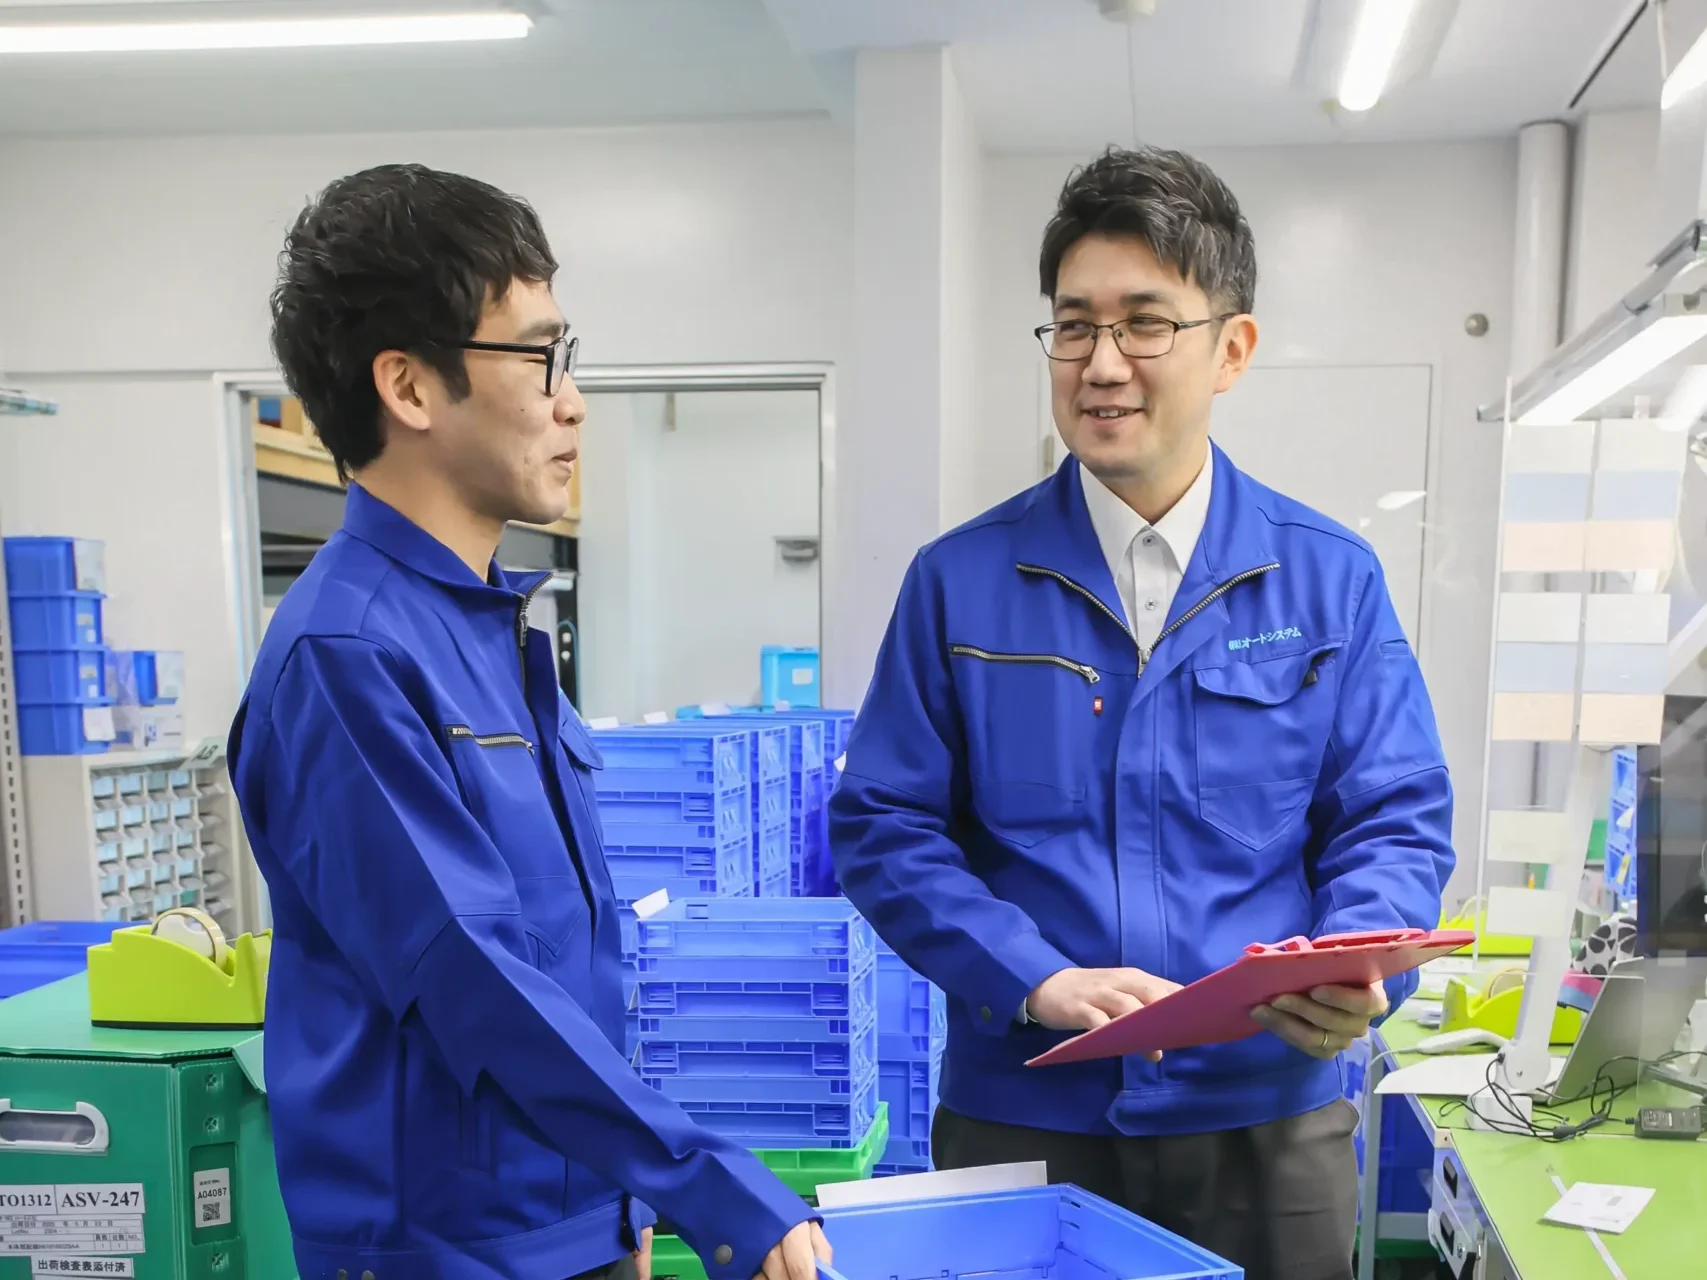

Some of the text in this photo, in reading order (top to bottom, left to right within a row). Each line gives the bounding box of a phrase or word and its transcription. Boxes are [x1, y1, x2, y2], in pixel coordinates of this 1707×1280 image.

[61, 1191, 140, 1208] ASV-247
[197, 1187, 227, 1200] A04087
[37, 1259, 126, 1272] 出荷検査表添付済
